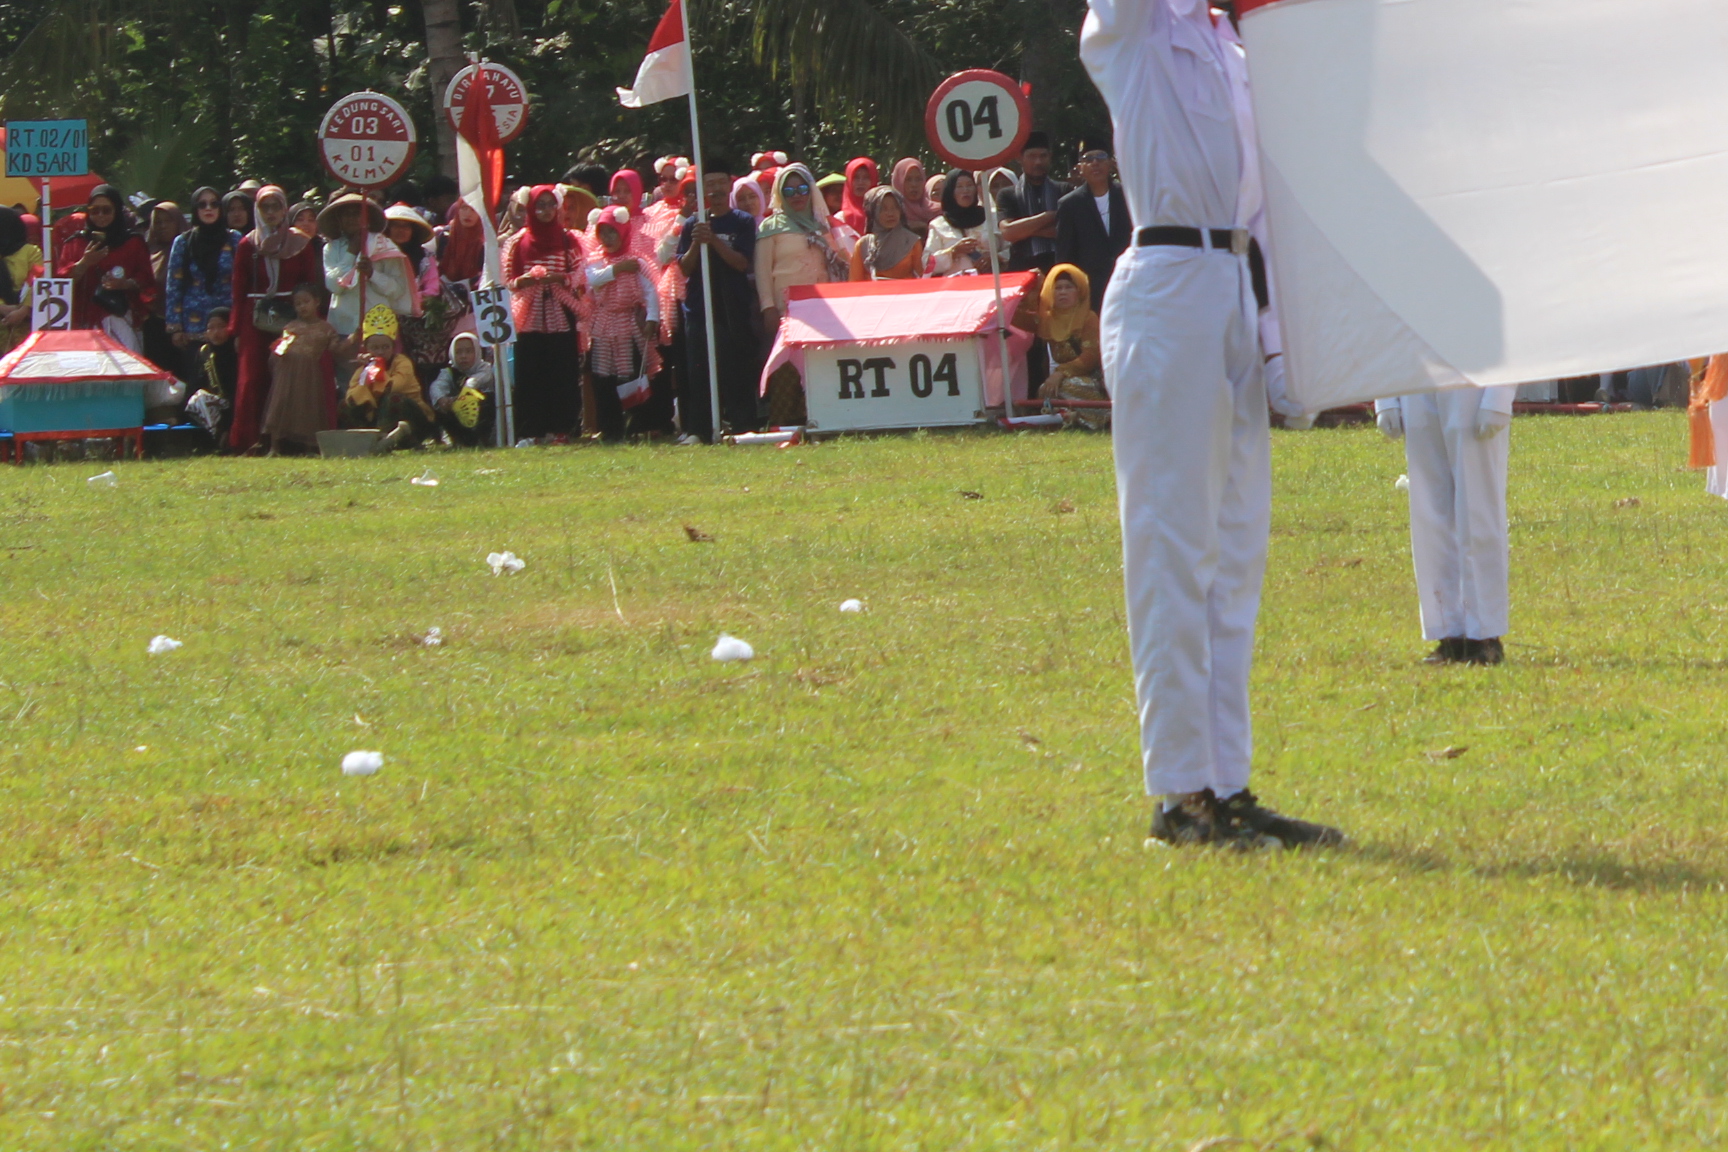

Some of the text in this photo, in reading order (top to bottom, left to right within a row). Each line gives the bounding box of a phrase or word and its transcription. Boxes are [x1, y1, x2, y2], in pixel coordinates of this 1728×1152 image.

[453, 71, 520, 101] DIRAHAYU
[351, 116, 379, 135] 03
[945, 95, 1003, 143] 04
[332, 154, 395, 179] KALMIT
[350, 145, 375, 162] 01
[37, 281, 70, 296] RT
[474, 286, 506, 306] RT
[38, 297, 70, 331] 2
[480, 305, 512, 344] 3
[836, 352, 961, 400] RT 04
